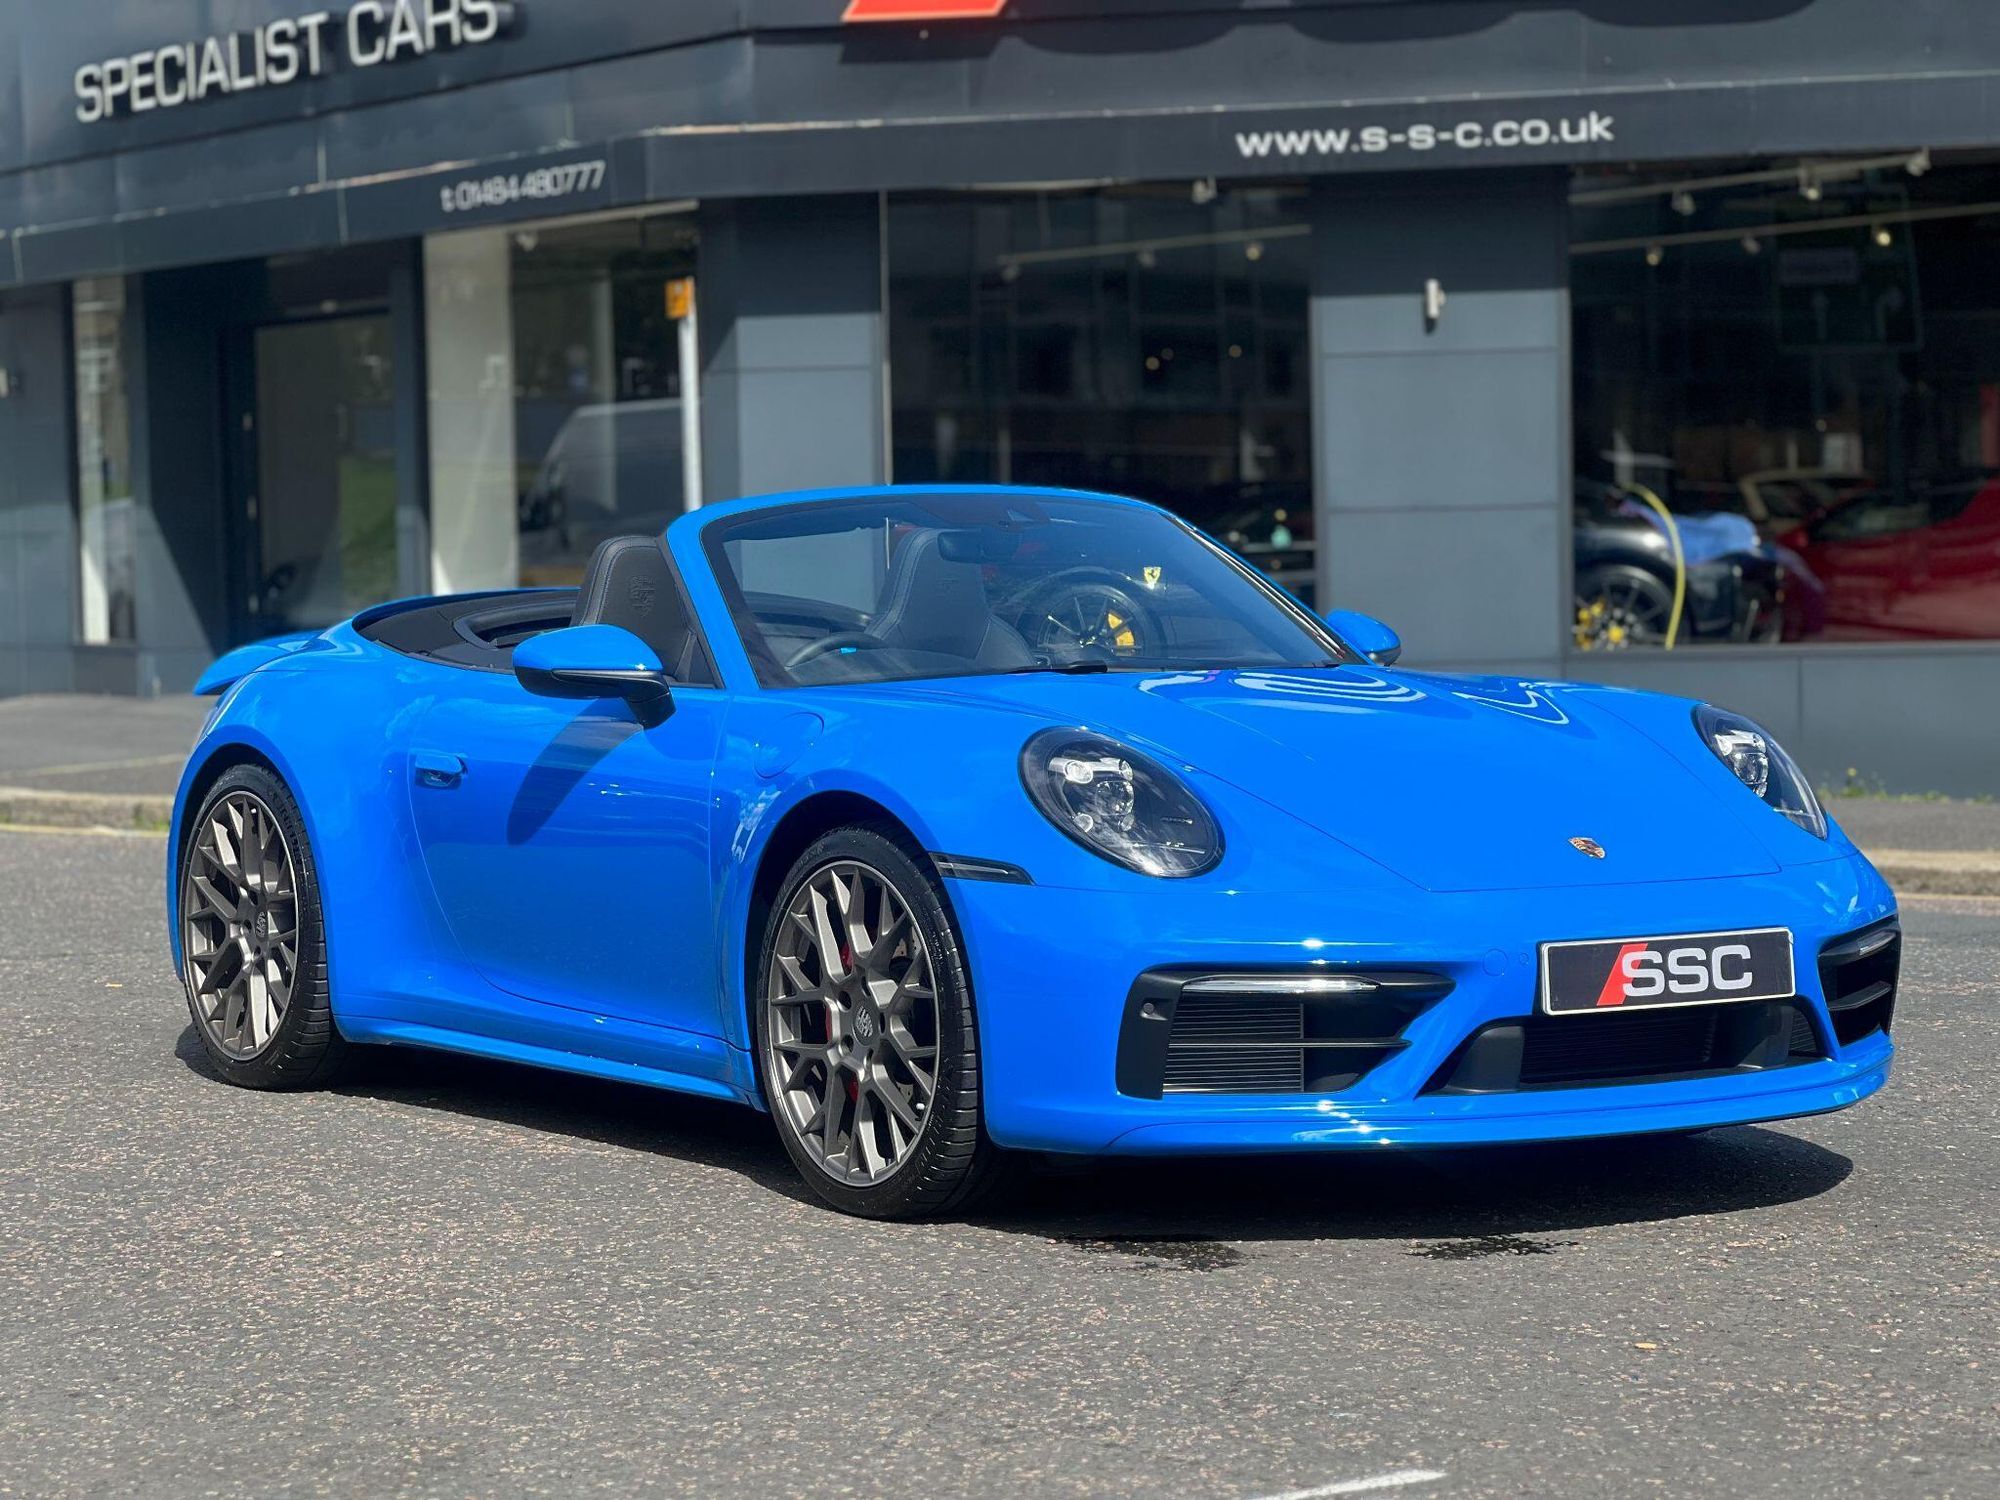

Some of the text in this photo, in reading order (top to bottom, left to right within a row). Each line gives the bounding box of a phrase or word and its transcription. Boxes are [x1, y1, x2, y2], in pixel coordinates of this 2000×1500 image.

[74, 0, 499, 123] SPECIALIST CARS
[1235, 111, 1615, 157] www.s-s-c.co.uk
[1622, 944, 1753, 997] SSC
